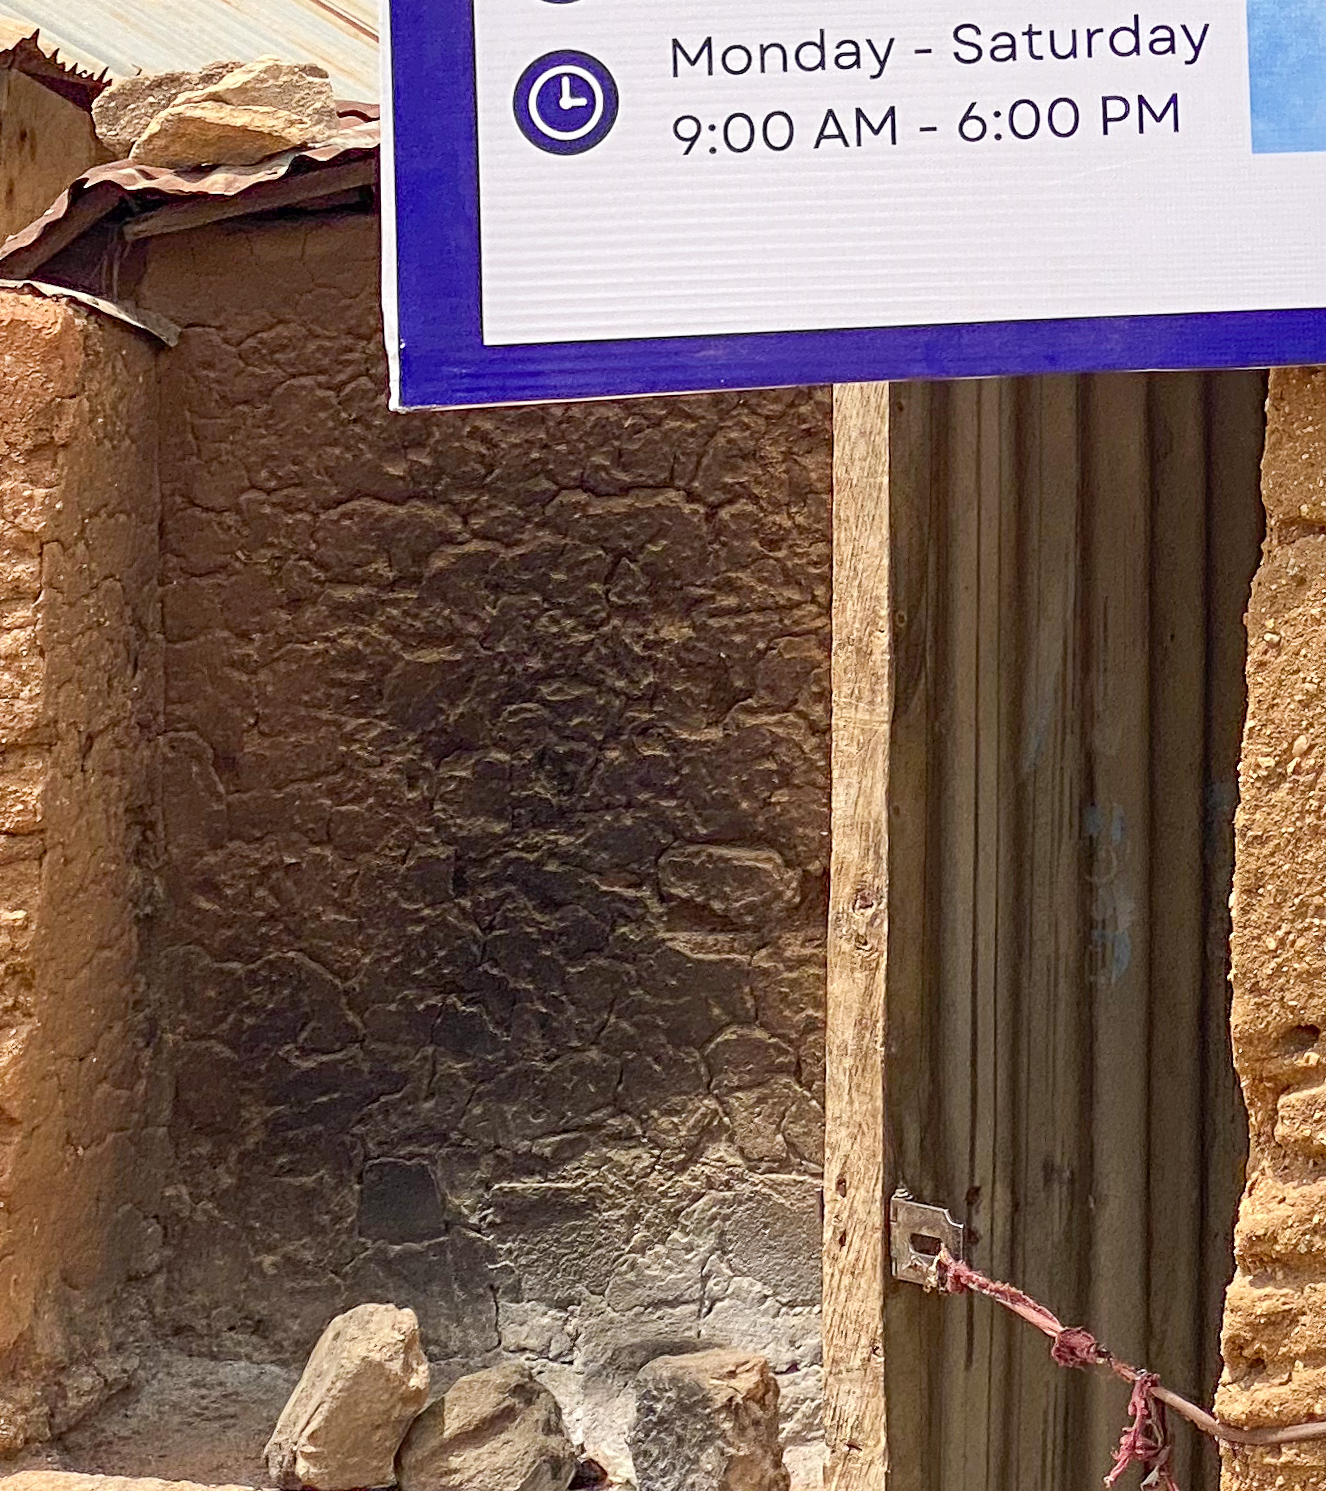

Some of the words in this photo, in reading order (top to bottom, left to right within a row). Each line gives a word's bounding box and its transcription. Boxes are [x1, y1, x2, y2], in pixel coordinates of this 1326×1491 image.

[671, 28, 895, 80] Monday
[952, 13, 1210, 65] Saturday
[672, 110, 794, 156] 9:00
[813, 105, 897, 149] AM
[958, 97, 1080, 143] 6:00
[1101, 92, 1179, 136] PM
